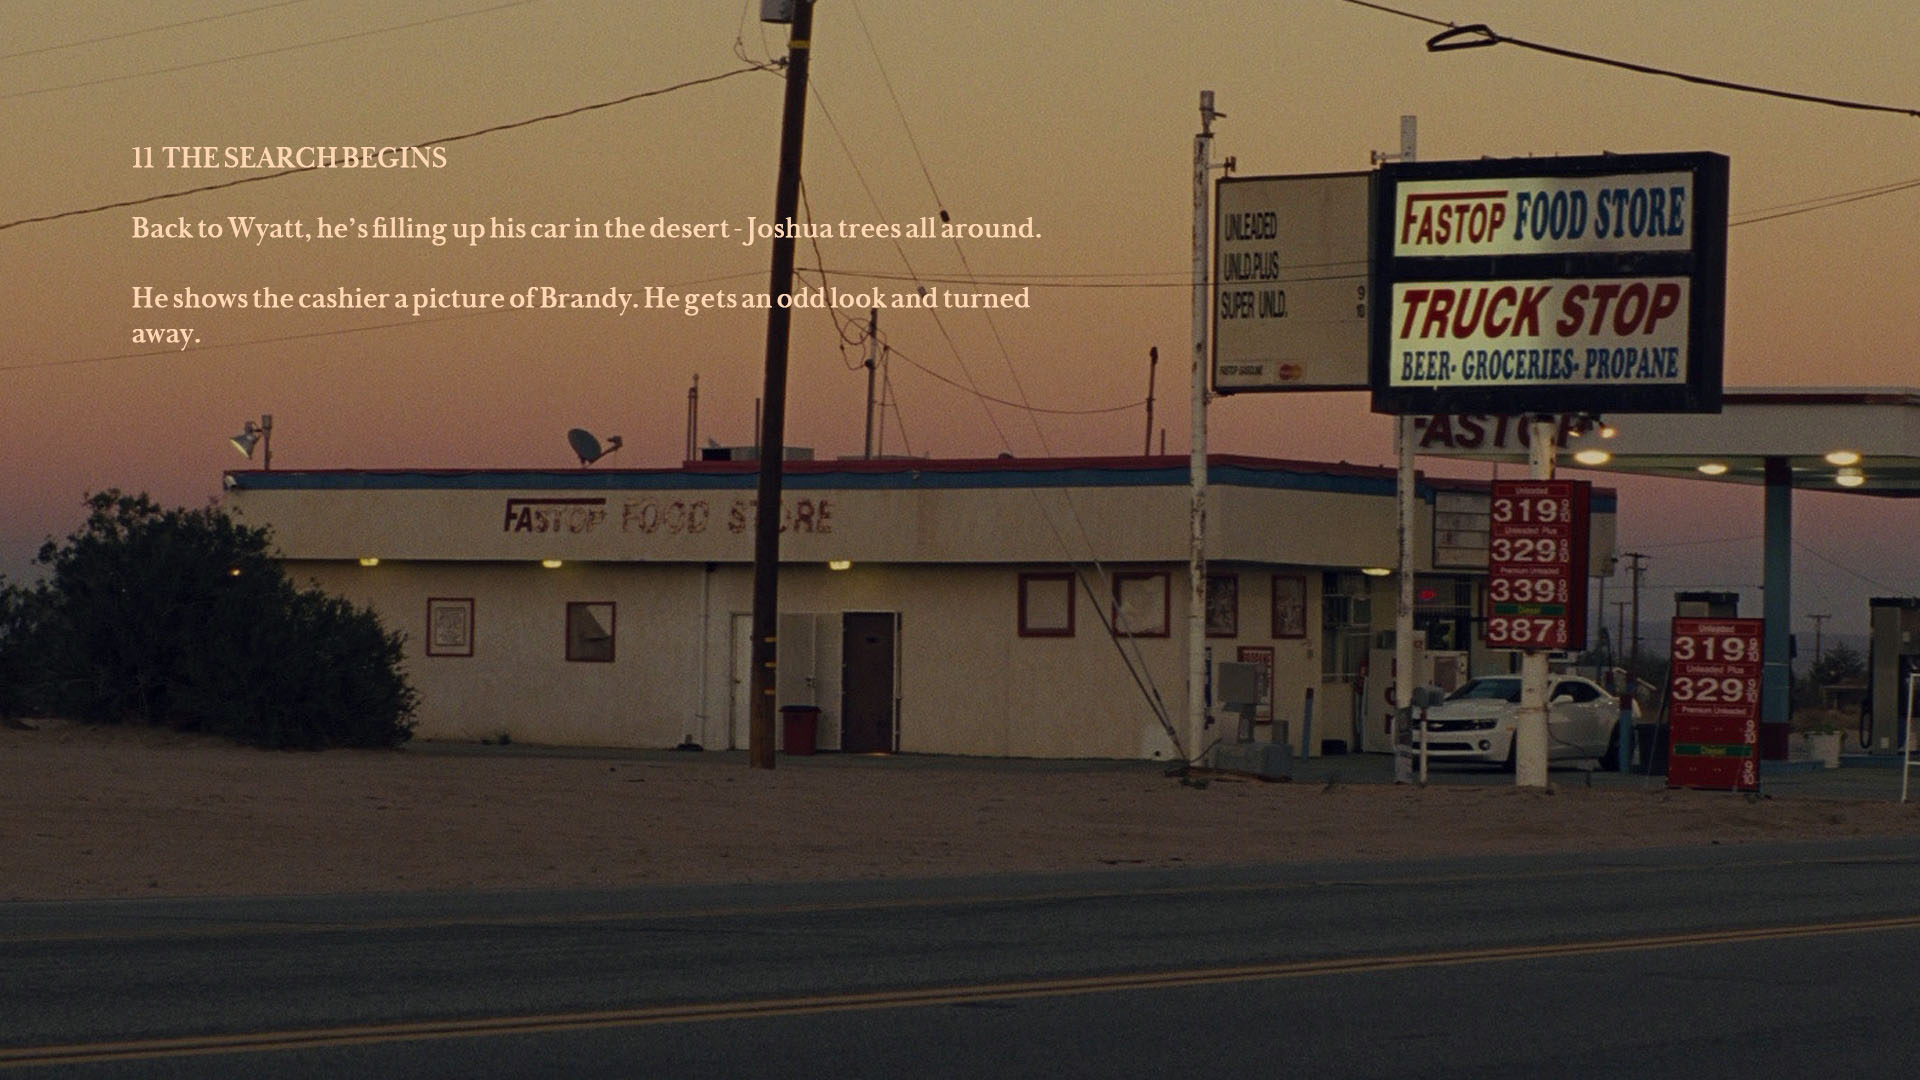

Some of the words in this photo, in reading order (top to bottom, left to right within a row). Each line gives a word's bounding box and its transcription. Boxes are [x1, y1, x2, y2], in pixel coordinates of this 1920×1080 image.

[1225, 212, 1277, 241] UNLEADED
[1401, 190, 1508, 245] FASTOP
[1514, 190, 1588, 241] FOOD
[1595, 186, 1685, 238] STORE
[1221, 291, 1255, 319] SUPER
[1259, 290, 1288, 318] UNLD.
[1400, 285, 1553, 340] TRUCK
[1556, 282, 1681, 337] STOP
[1585, 347, 1679, 380] PROPANE
[622, 499, 709, 533] FOOD
[1493, 498, 1558, 522] 319
[1491, 538, 1556, 562] 329
[1490, 578, 1555, 602] 339
[1489, 618, 1554, 642] 387
[1698, 624, 1735, 634] Unleaded
[1673, 636, 1745, 661] 319
[1686, 665, 1724, 674] Unleaded
[1727, 666, 1745, 674] Plus
[1672, 677, 1744, 702] 329
